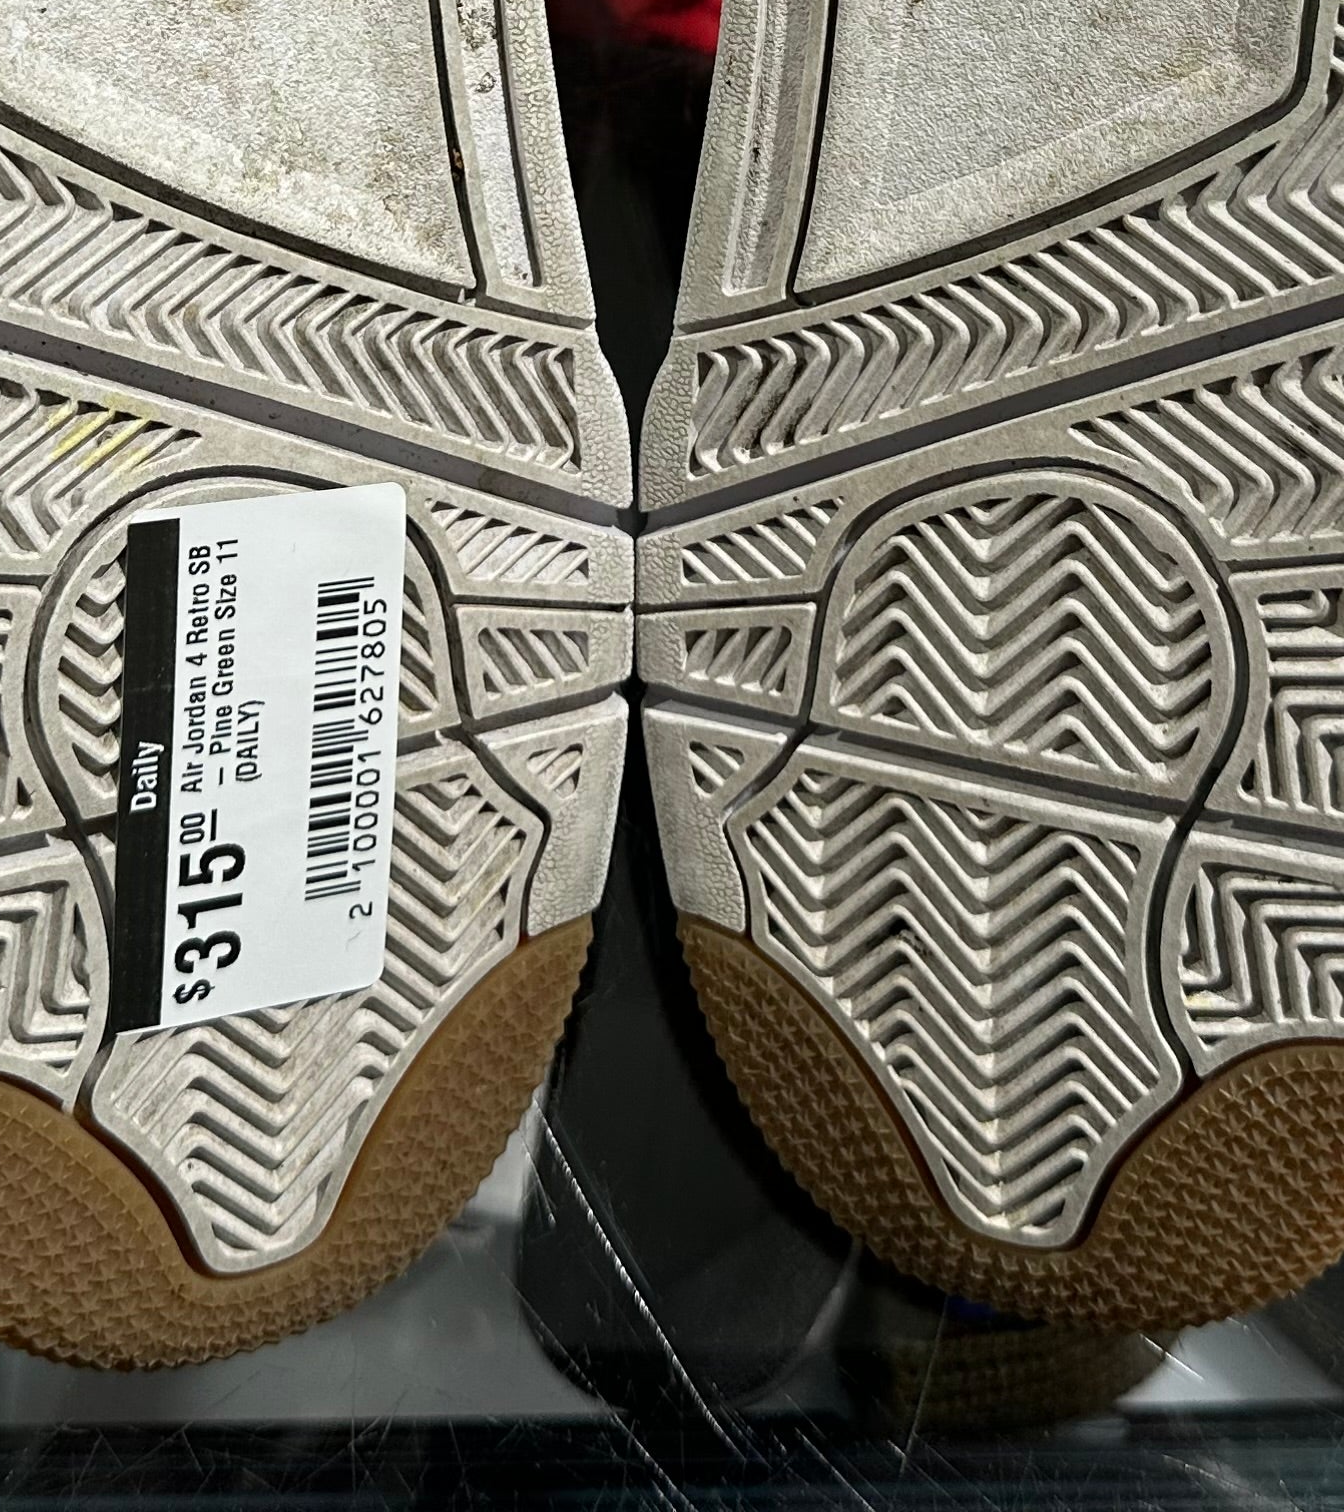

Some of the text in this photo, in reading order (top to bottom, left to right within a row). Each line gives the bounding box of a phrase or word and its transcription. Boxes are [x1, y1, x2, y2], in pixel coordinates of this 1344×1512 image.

[216, 539, 238, 564] 11
[214, 574, 237, 620] Size
[180, 545, 211, 792] Air Jordan 4 Retro SB
[212, 628, 236, 696] Green
[209, 705, 233, 755] Pine
[235, 700, 265, 783] (DAILY)
[349, 598, 387, 920] 2 100001 627805
[130, 741, 165, 814] Daily
